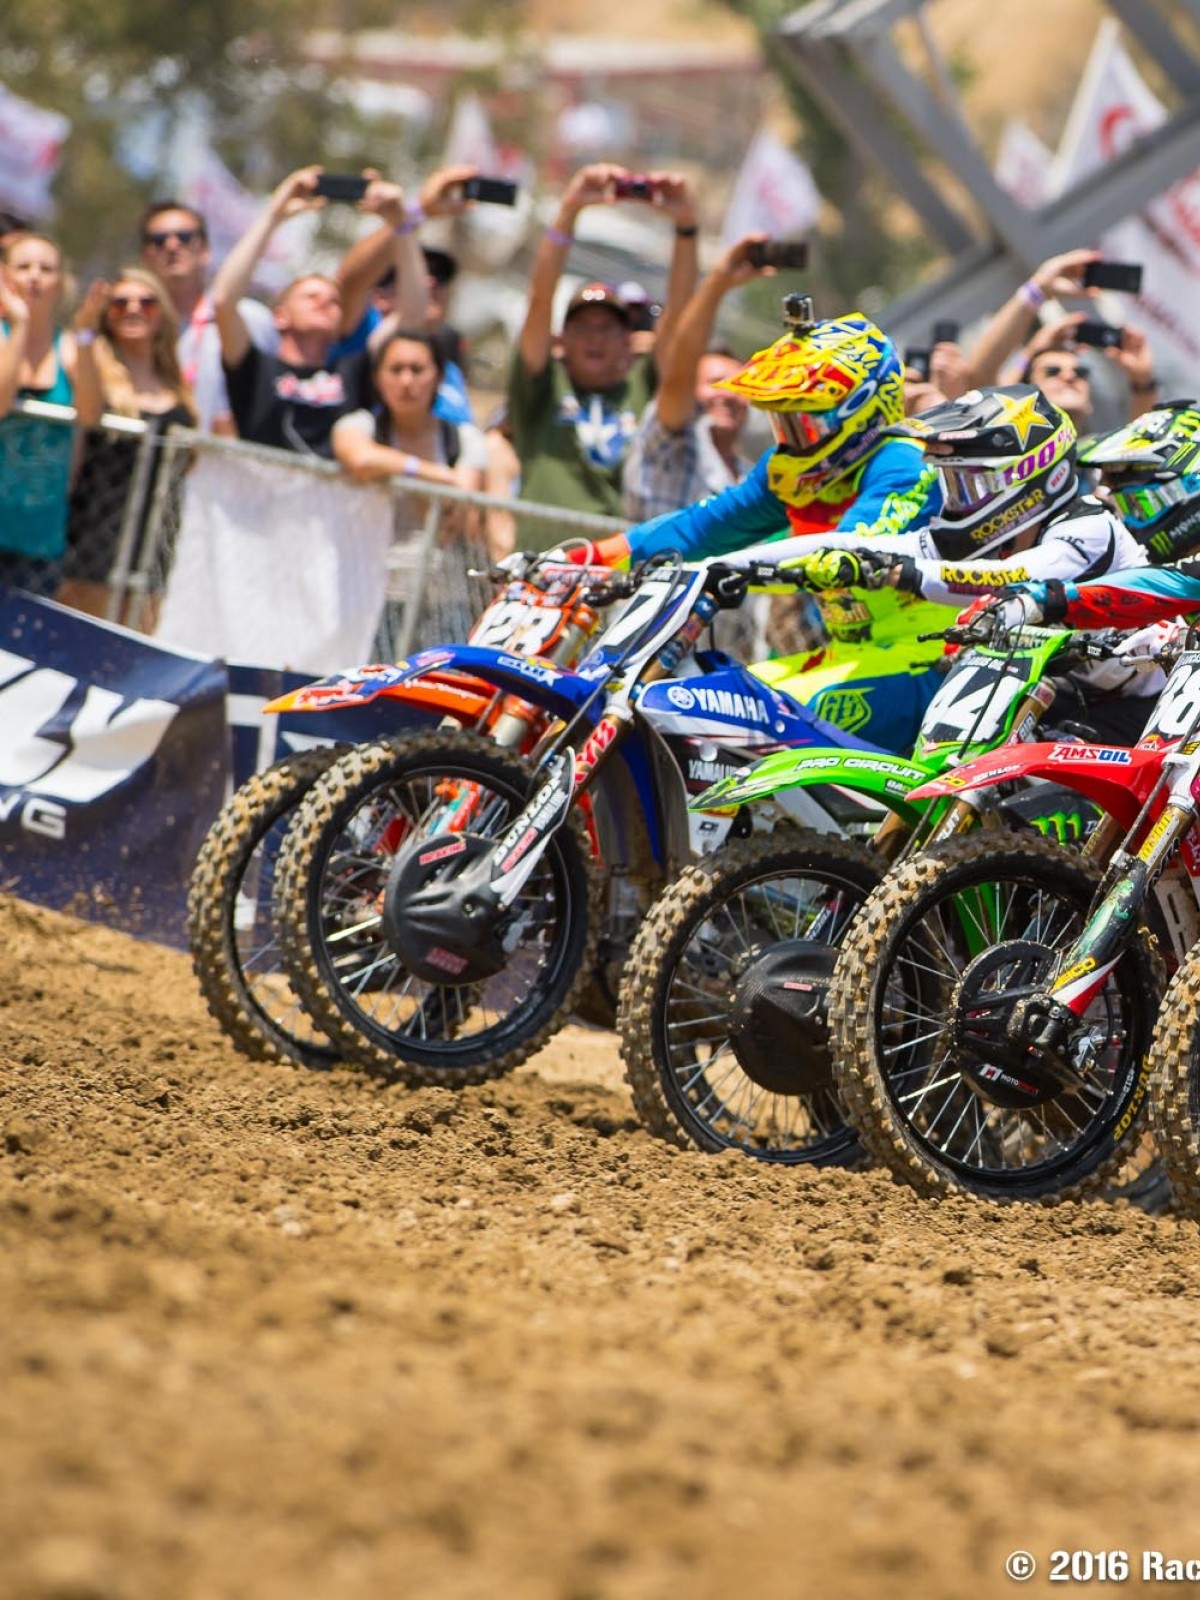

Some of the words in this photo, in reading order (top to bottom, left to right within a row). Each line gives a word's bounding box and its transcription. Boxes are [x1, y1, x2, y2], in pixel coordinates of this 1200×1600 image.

[691, 688, 770, 724] YAMAHA
[1049, 744, 1132, 765] AMSOIL
[795, 756, 841, 772] PRO
[844, 758, 927, 781] CIRCUIT
